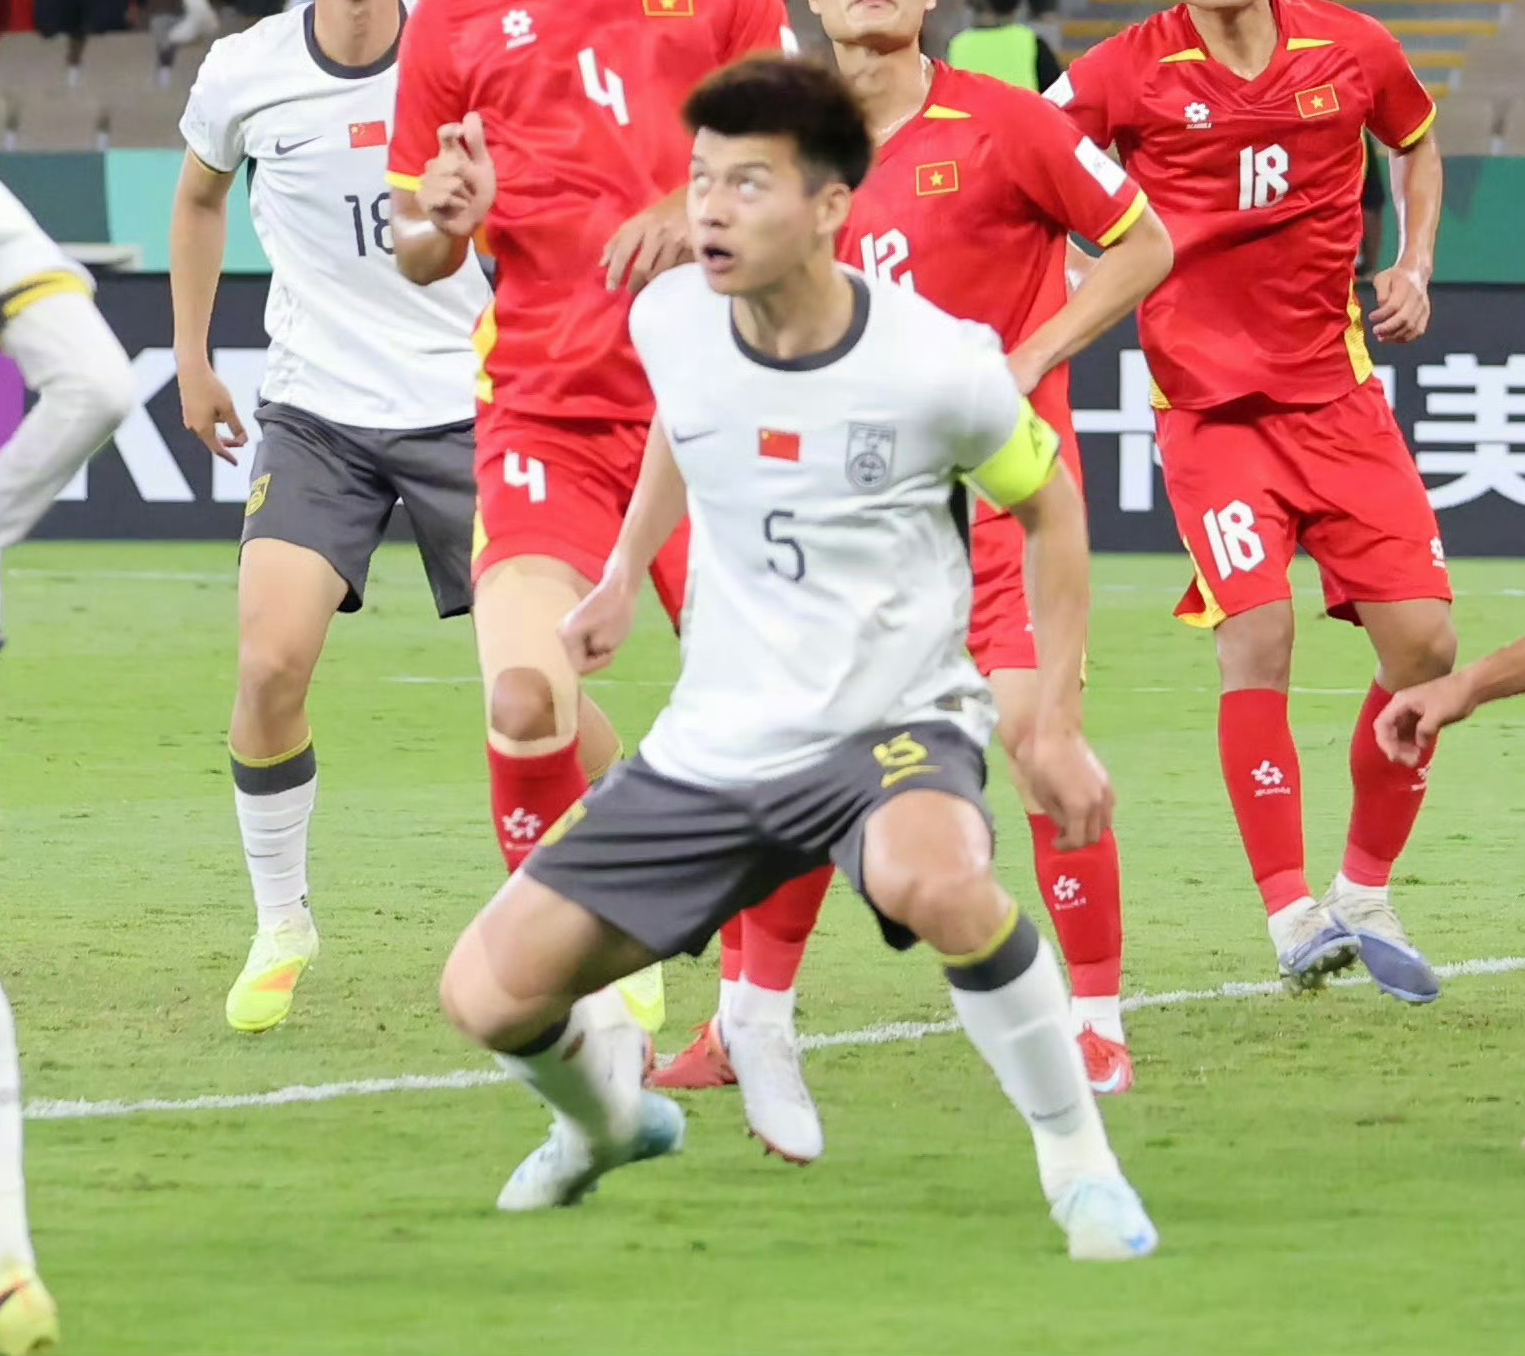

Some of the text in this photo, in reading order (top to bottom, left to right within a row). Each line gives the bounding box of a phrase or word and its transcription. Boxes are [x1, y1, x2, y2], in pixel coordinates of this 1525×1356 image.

[577, 46, 631, 127] 4
[1239, 143, 1290, 211] 18
[860, 227, 915, 293] 12
[503, 448, 546, 503] 4
[762, 508, 806, 583] 5
[1202, 499, 1266, 581] 18
